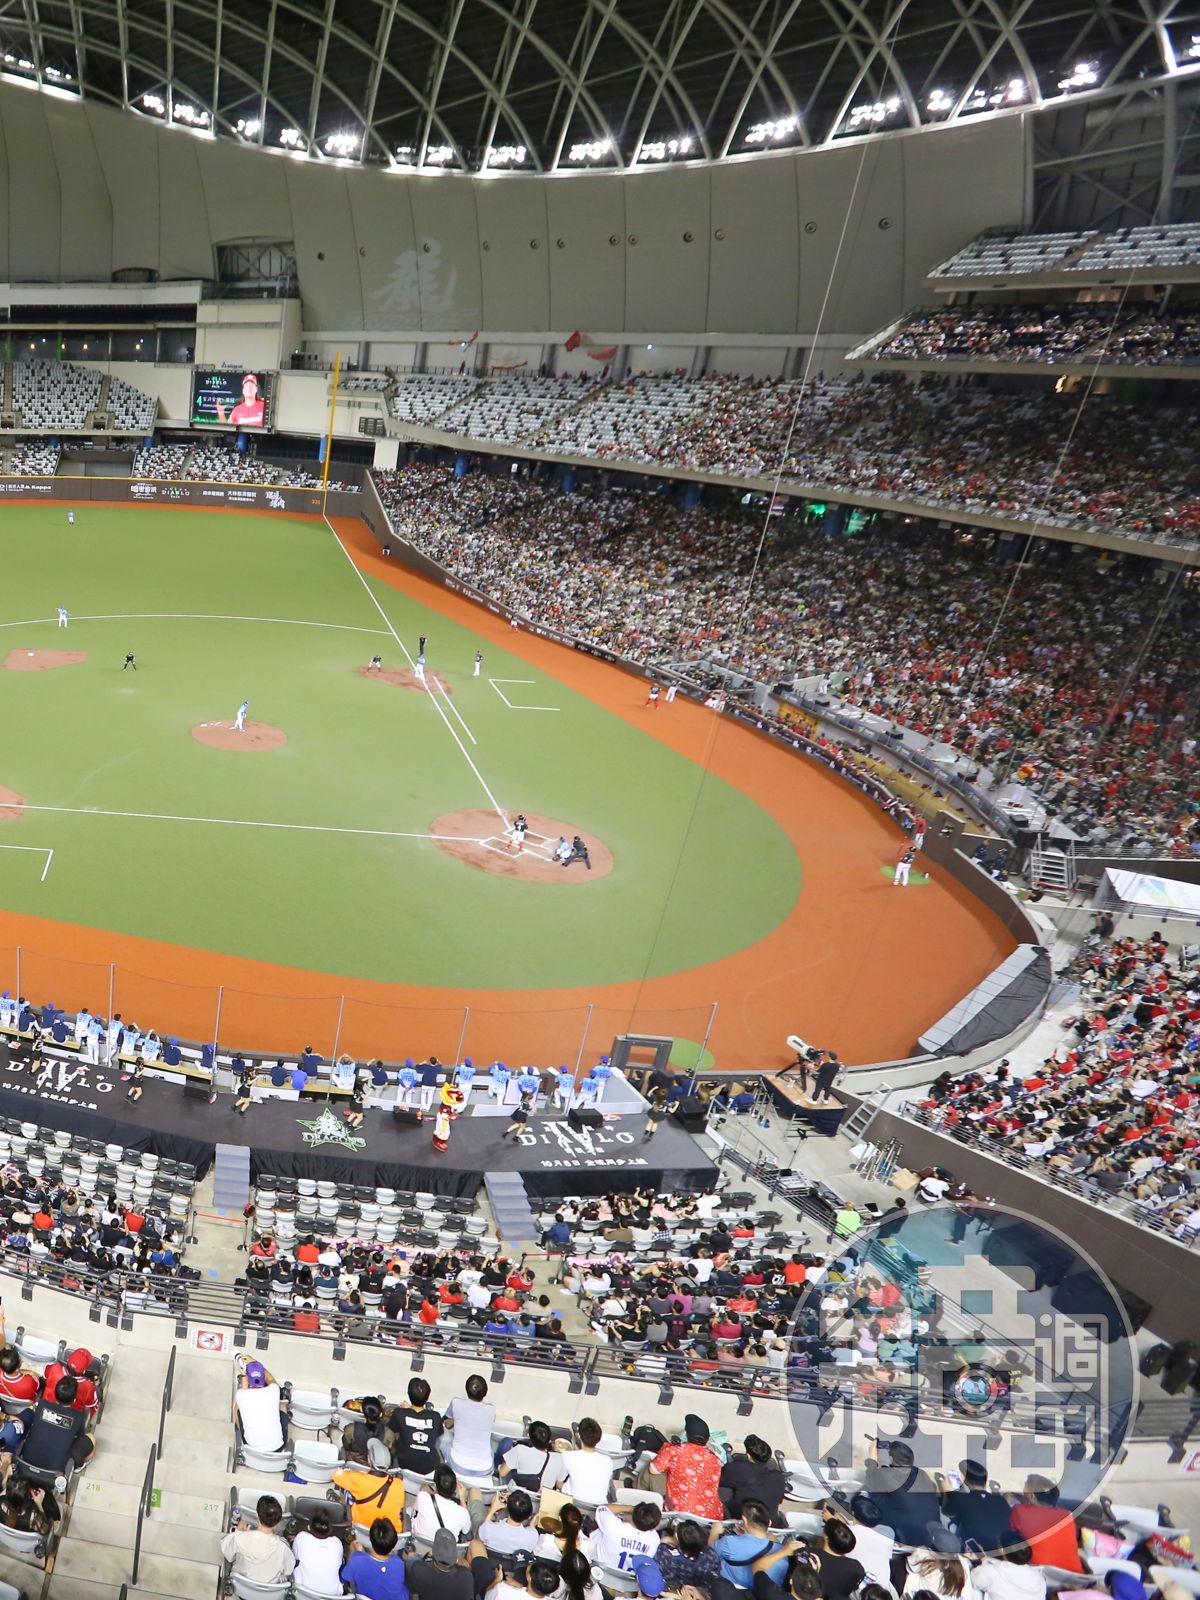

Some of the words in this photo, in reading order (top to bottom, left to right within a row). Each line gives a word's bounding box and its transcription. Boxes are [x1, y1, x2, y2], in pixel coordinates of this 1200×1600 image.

[161, 489, 190, 497] DIABLO
[1, 1082, 37, 1095] 10月8日
[39, 1092, 98, 1111] 全球同步上線
[302, 1131, 366, 1147] DRAGONS
[584, 1158, 649, 1167] 全球同步上線
[86, 1482, 101, 1492] 218
[203, 1503, 219, 1512] 217
[620, 1537, 651, 1554] OHTANI
